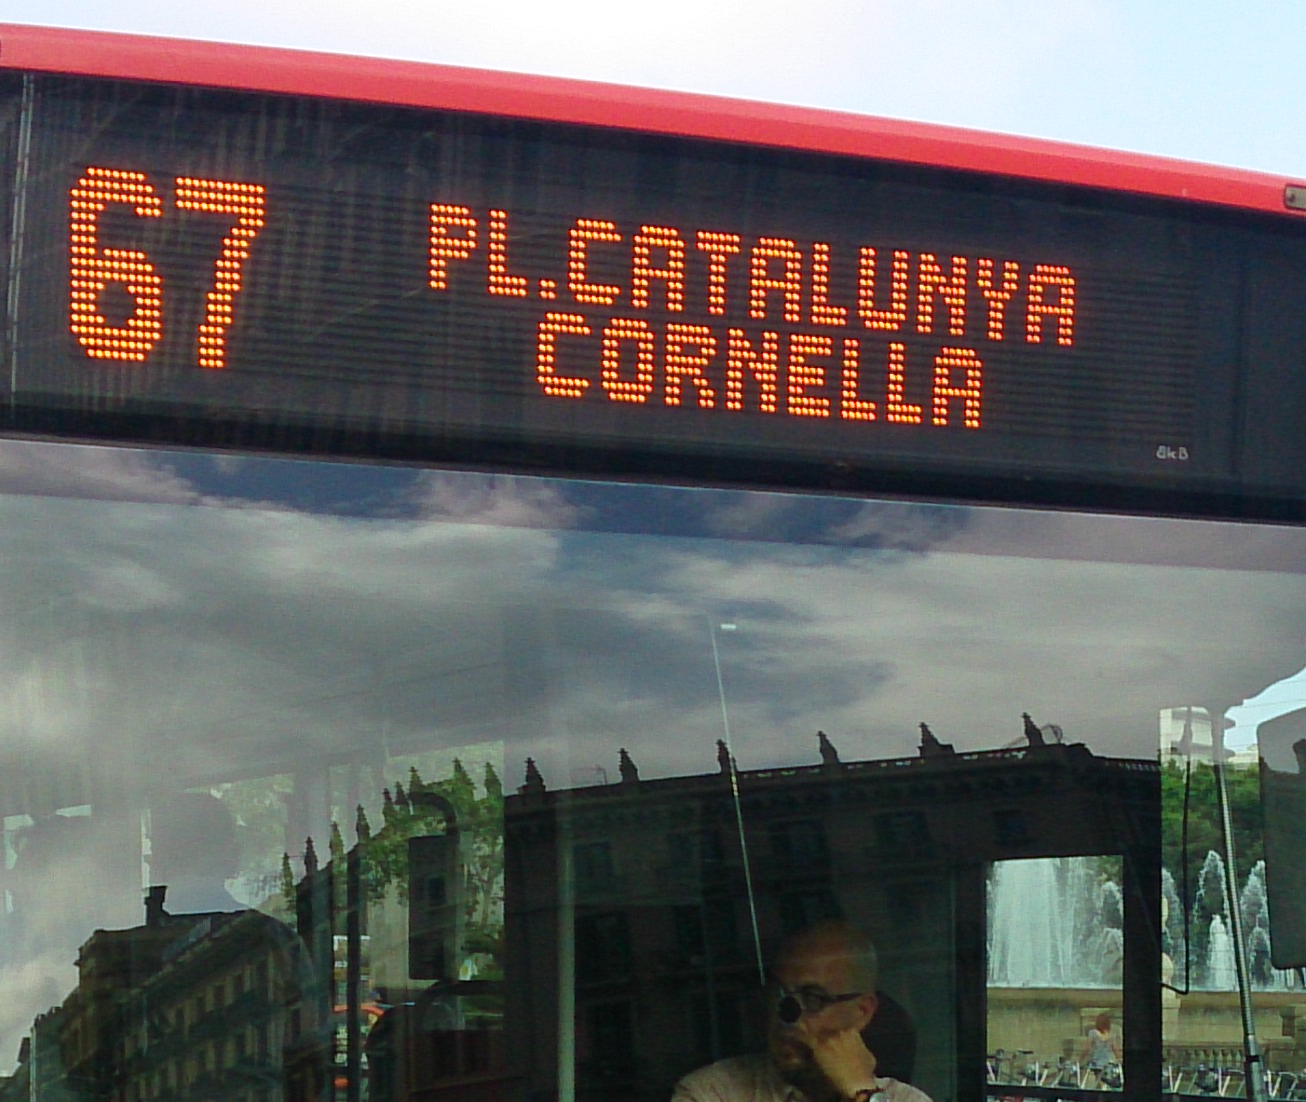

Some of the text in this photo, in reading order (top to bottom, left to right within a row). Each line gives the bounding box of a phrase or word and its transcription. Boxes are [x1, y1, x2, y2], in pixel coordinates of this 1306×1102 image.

[69, 167, 265, 368] 67
[429, 204, 1075, 346] PL.CATALUNYA
[537, 312, 982, 428] CORNELLA
